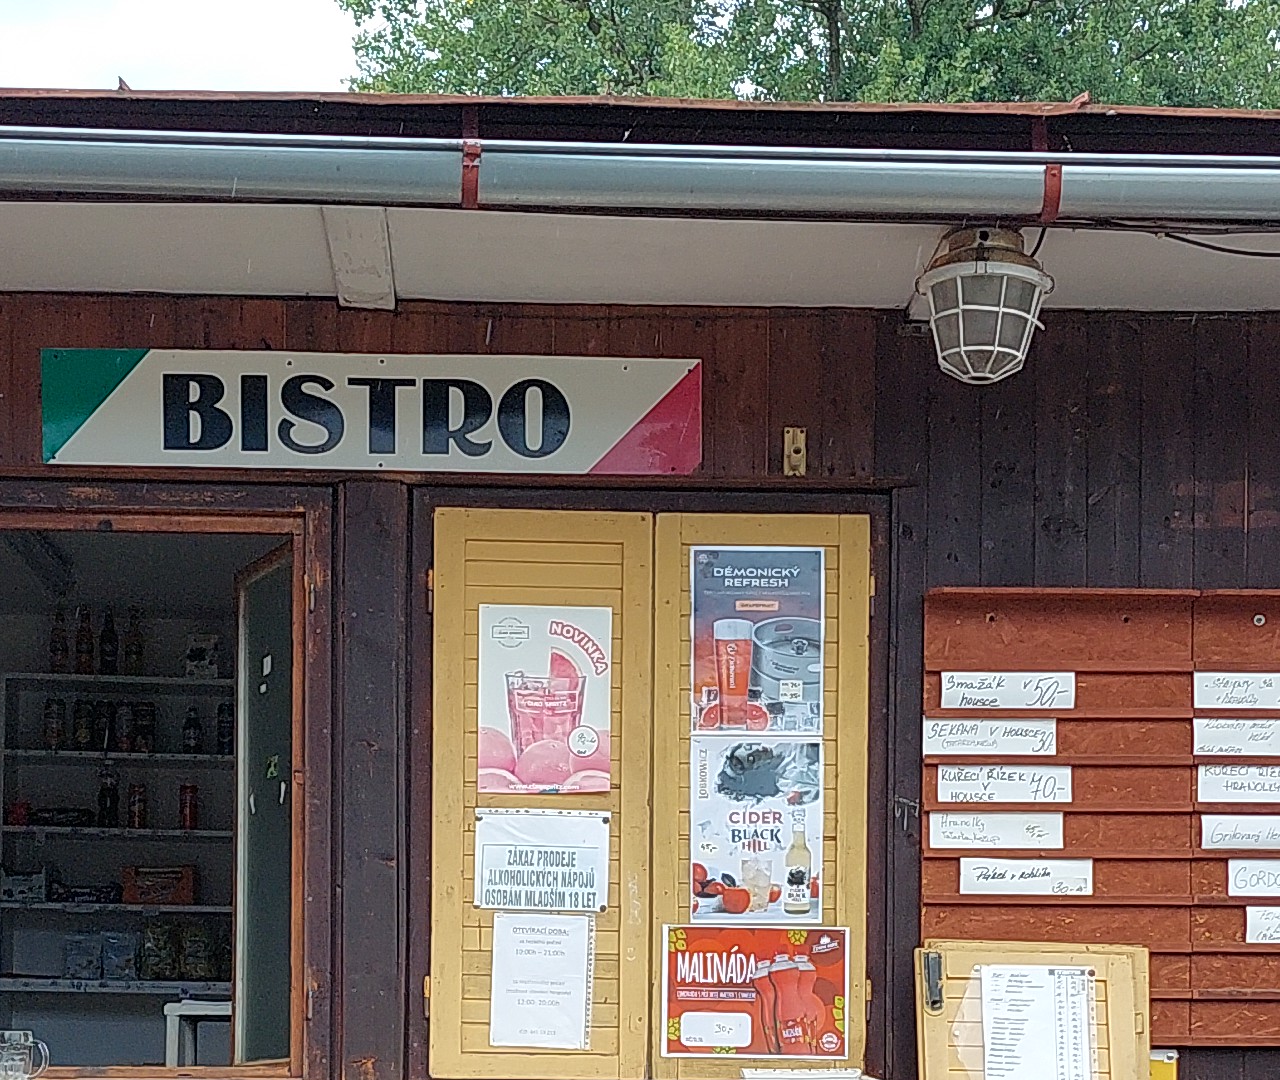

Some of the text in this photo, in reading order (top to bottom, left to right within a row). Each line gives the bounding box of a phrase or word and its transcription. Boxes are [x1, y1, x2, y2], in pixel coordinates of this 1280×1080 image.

[162, 372, 571, 458] BISTRO
[713, 565, 801, 577] DÉMONICKÝ
[724, 579, 789, 587] REFRESH
[549, 620, 608, 676] NOVINKA
[945, 675, 1005, 691] Smažák
[959, 689, 1001, 707] housce
[941, 766, 983, 782] KUŘECÍ
[987, 766, 1027, 782] ŘÍZEK
[950, 791, 996, 802] HOUSCE
[729, 811, 784, 824] CIDER
[731, 828, 782, 843] BLACK
[742, 839, 771, 851] HILL
[507, 846, 577, 868] ZÁKAZ PRODEJE
[487, 867, 595, 889] ALKOHOLICKÝCH NÁPOJŮ
[484, 887, 597, 908] OSOBÁM MLADŠÍM 18 LET
[677, 946, 757, 984] MALINÁDA
